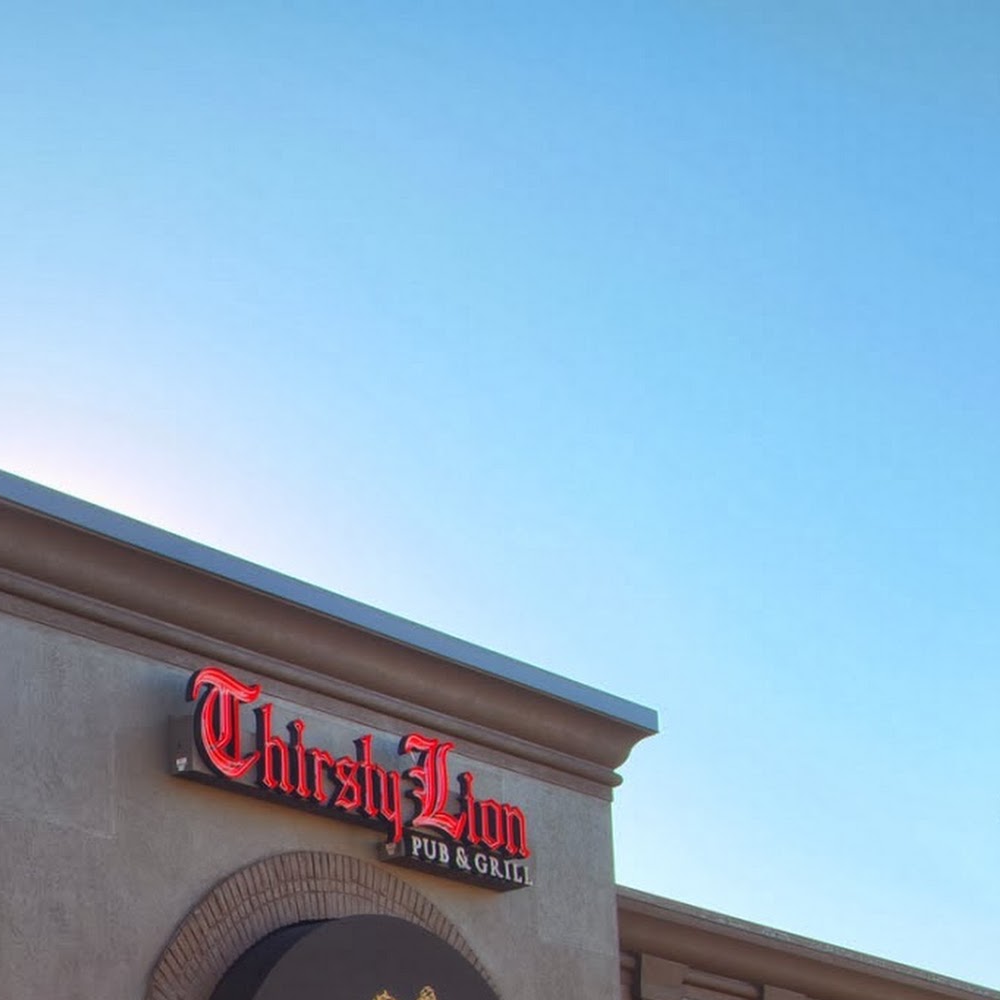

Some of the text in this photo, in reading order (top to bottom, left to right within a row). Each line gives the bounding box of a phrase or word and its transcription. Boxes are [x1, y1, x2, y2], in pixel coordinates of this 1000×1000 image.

[193, 667, 531, 858] Thirsty Lion
[411, 836, 533, 886] PUB & GRILL
